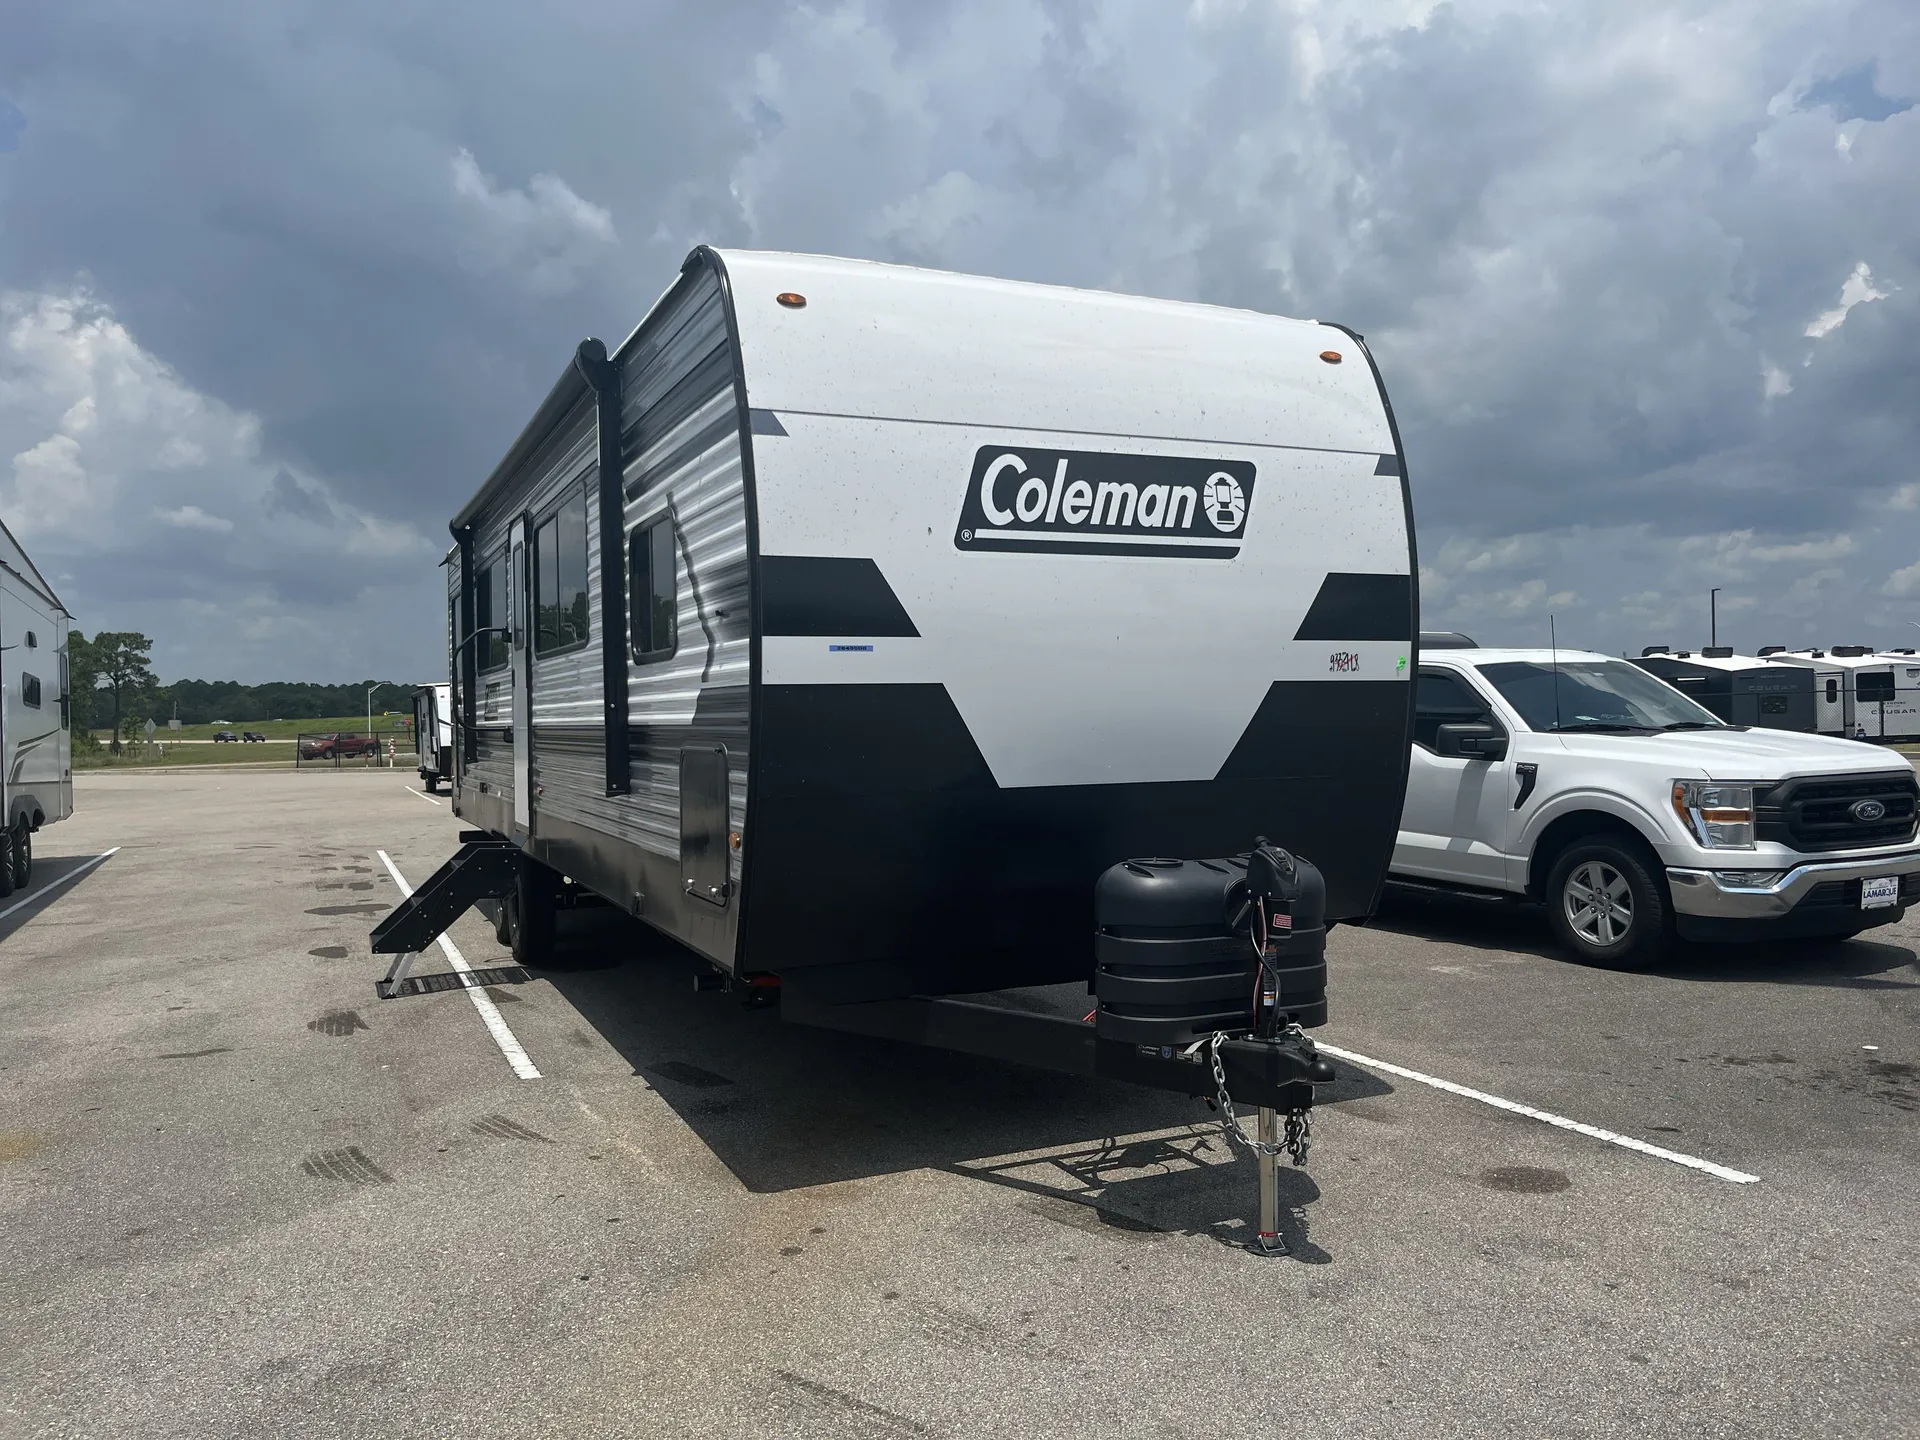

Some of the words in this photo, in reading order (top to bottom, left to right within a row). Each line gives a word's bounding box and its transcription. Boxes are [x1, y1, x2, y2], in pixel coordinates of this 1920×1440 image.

[981, 453, 1198, 529] Coleman
[1864, 805, 1880, 817] Ford
[1863, 887, 1897, 899] LAMARQUE
